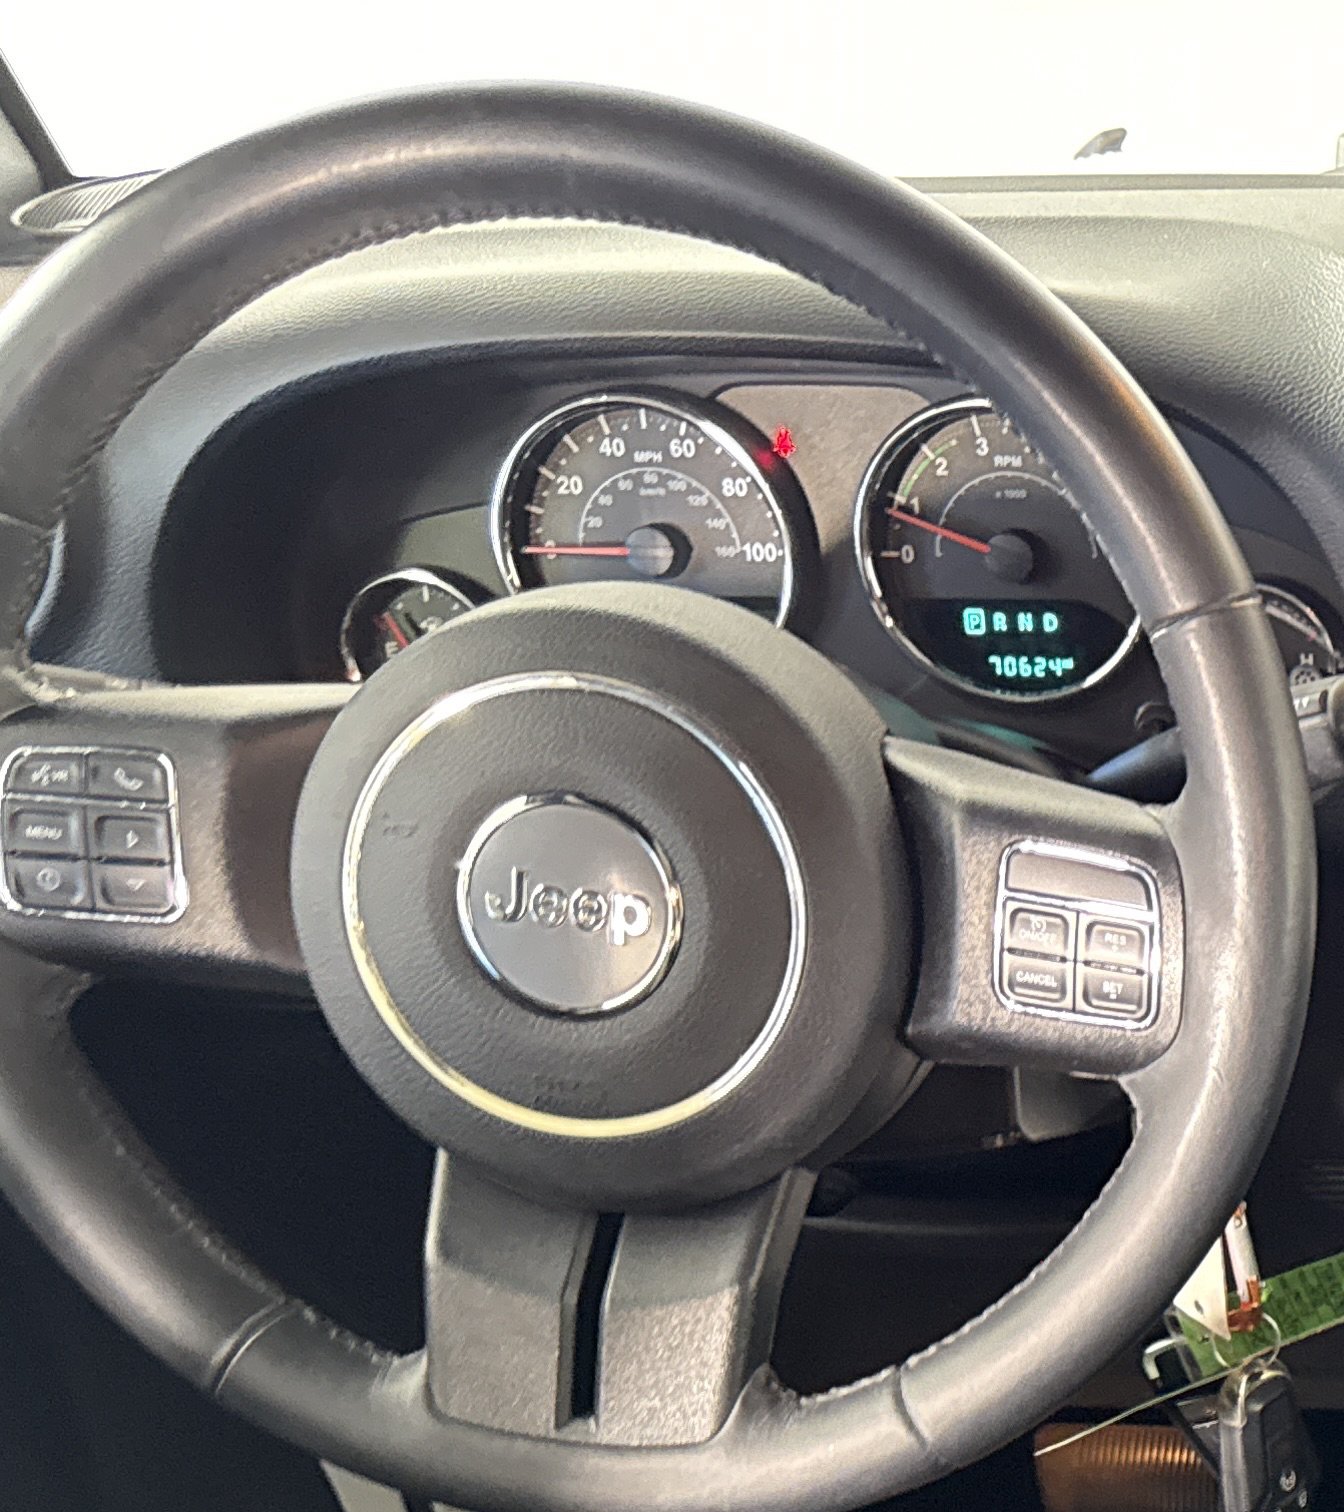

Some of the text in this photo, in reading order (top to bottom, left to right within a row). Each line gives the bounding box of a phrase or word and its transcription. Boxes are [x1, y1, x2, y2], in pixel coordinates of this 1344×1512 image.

[599, 437, 626, 458] 40
[633, 450, 663, 463] MPH
[669, 438, 696, 459] 60
[975, 436, 990, 457] 3
[934, 456, 949, 477] 2
[993, 455, 1023, 468] RPM
[556, 475, 583, 495] 20
[721, 477, 748, 498] 80
[909, 496, 920, 514] 1
[743, 542, 777, 562] 100
[901, 544, 915, 564] 0
[992, 611, 1008, 632] R
[1017, 611, 1034, 632] N
[1043, 612, 1058, 633] D
[484, 865, 652, 946] Jeep
[1016, 970, 1058, 988] CANCEL
